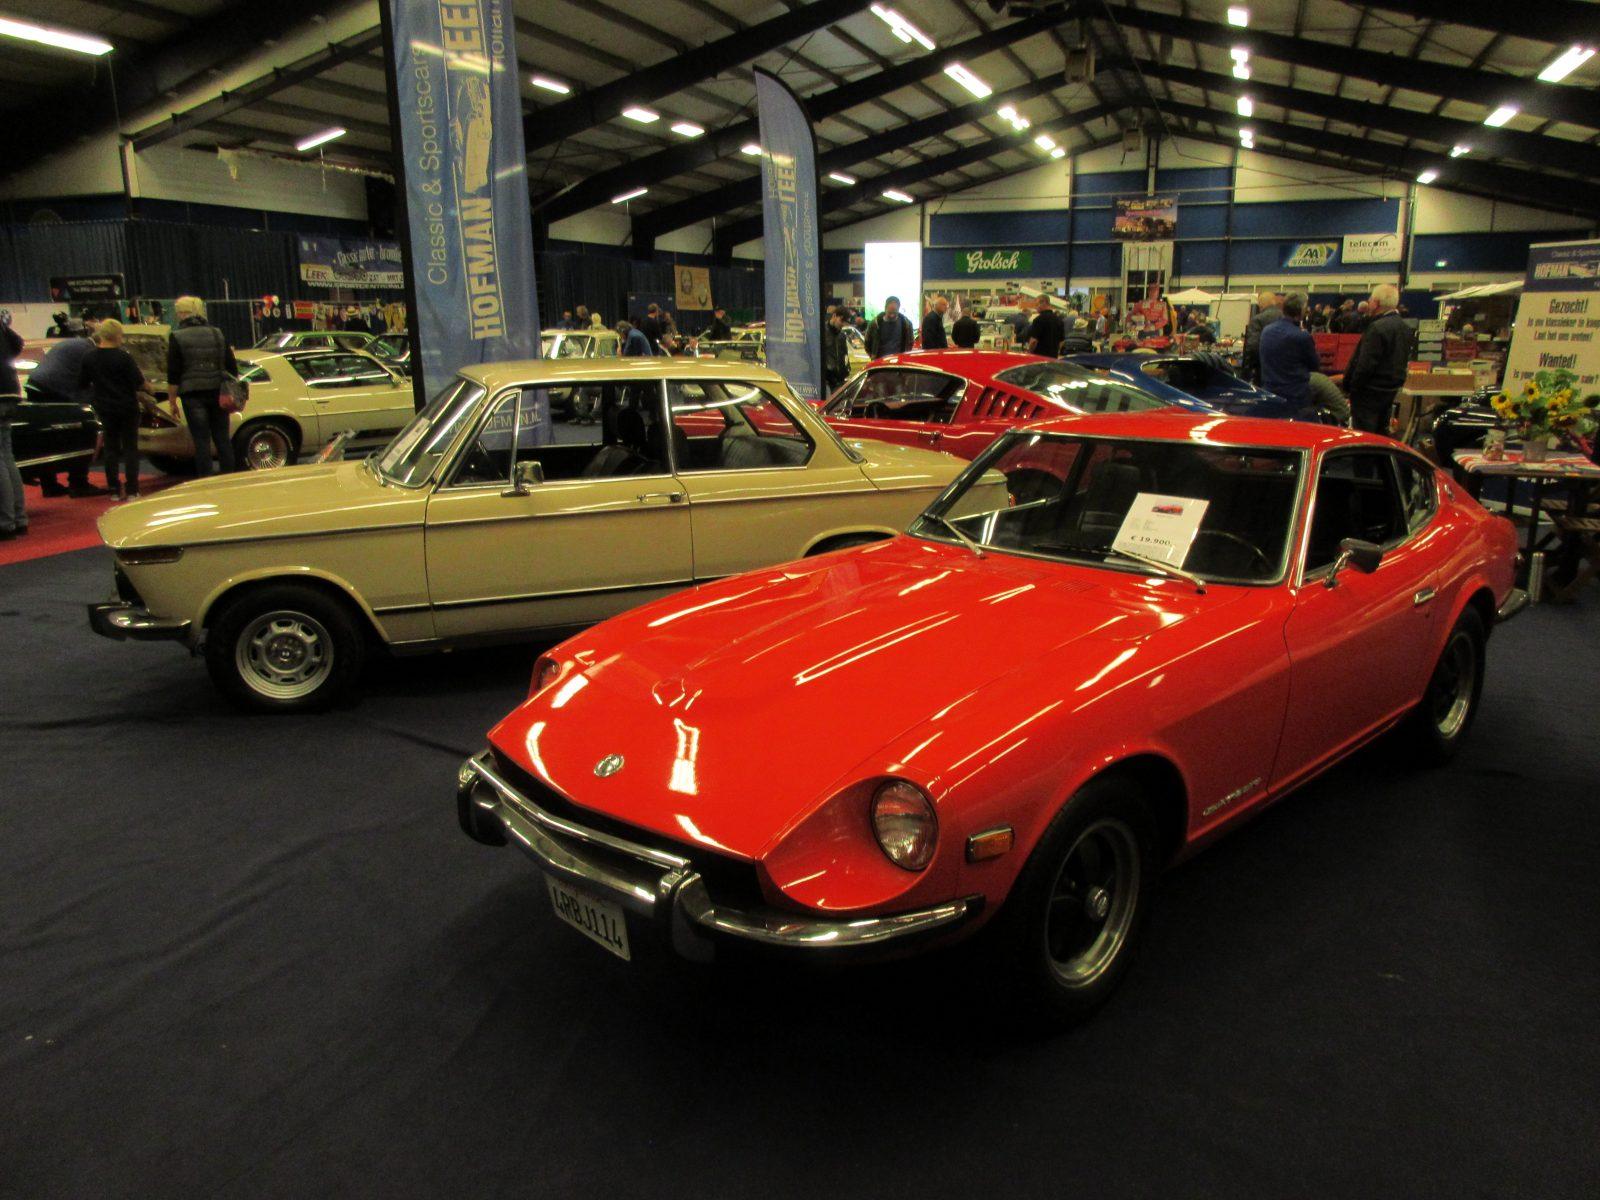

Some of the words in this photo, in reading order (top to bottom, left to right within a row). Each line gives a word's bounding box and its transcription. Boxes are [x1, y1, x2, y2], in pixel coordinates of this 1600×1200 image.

[441, 0, 489, 73] LEE
[411, 48, 442, 171] Sportscars
[422, 178, 442, 195] &
[425, 202, 448, 286] Classic
[1349, 240, 1389, 248] telecom
[966, 250, 1020, 273] Grolsch
[1303, 248, 1319, 259] AA
[461, 198, 503, 340] HOFMAN
[1534, 263, 1569, 279] HOFMAN
[1549, 298, 1588, 314] Gezocht!
[1538, 352, 1577, 369] Wanted!
